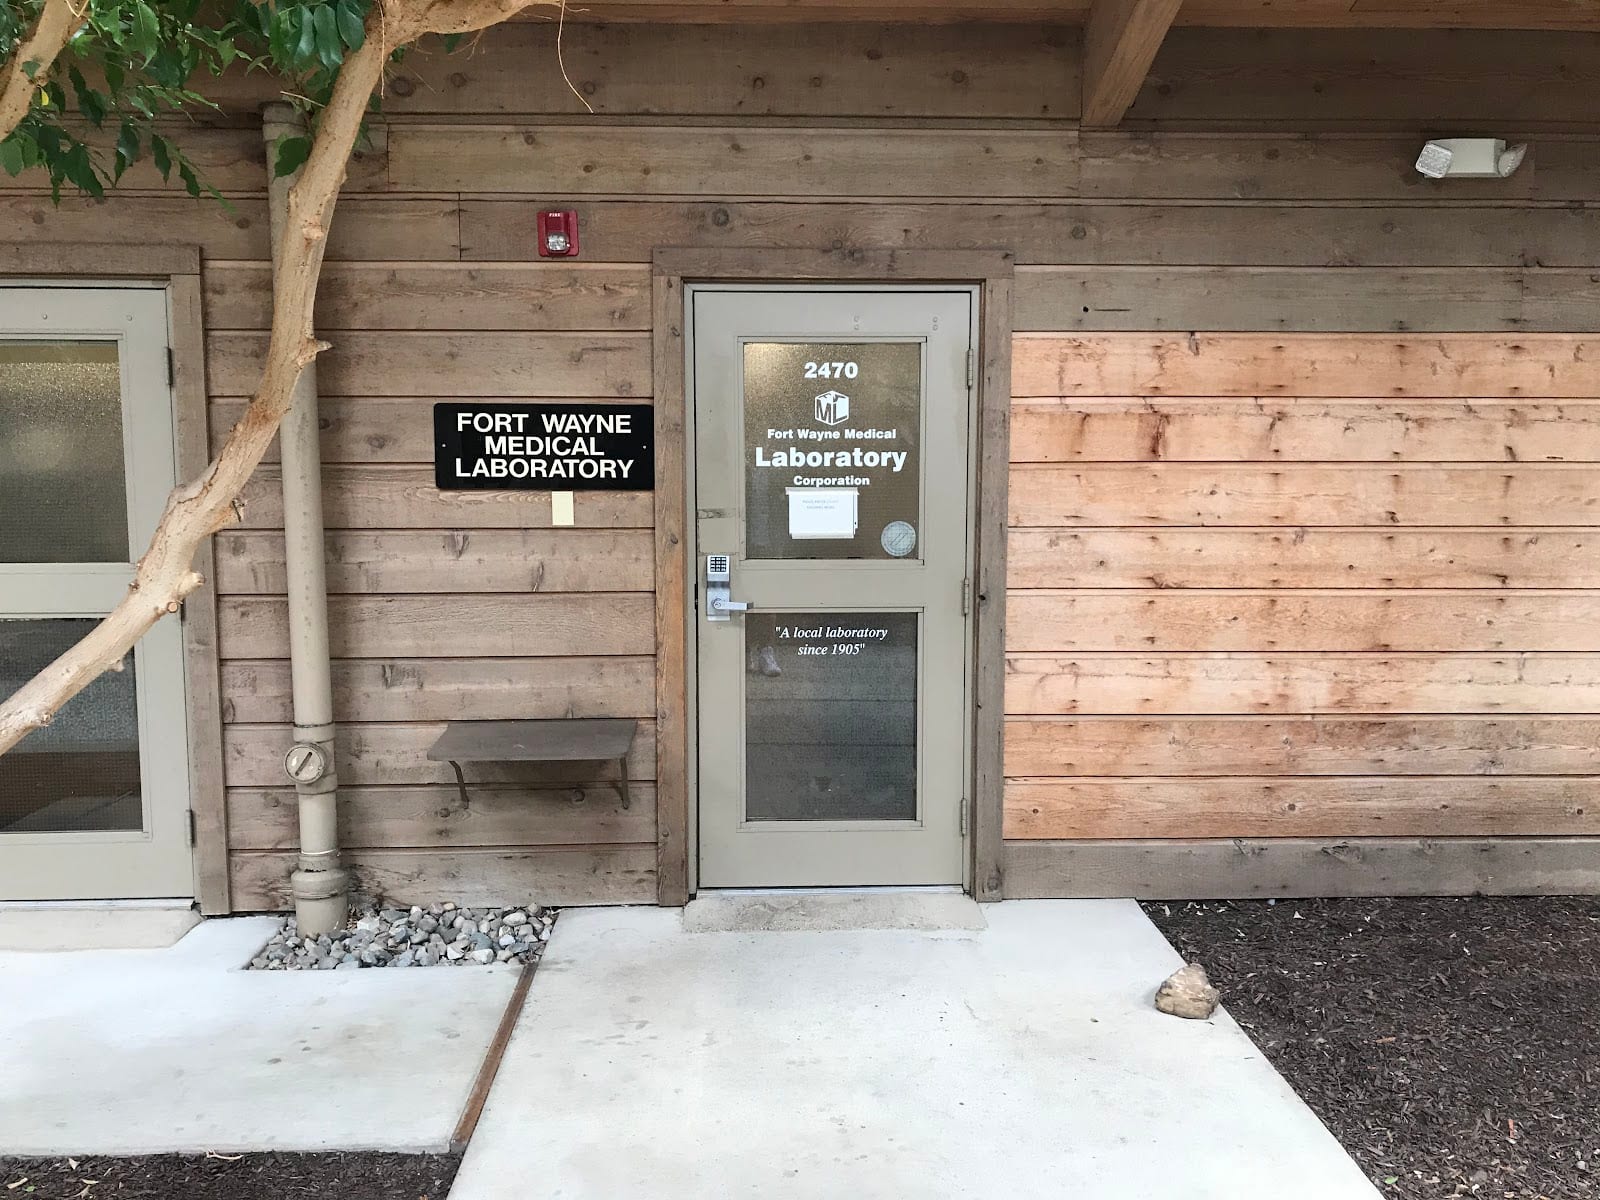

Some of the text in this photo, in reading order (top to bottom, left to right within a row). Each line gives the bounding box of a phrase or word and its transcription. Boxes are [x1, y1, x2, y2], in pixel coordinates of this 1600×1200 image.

[804, 362, 858, 378] 2470
[458, 413, 632, 434] FORT WAYNE
[768, 429, 896, 442] Fort Wayne Medical
[485, 436, 604, 456] MEDICAL
[755, 447, 907, 471] Laboratory
[456, 458, 634, 478] LABORATORY
[793, 475, 870, 487] Corporation
[776, 627, 888, 640] "A local laboratory
[798, 644, 865, 655] since 1905"
